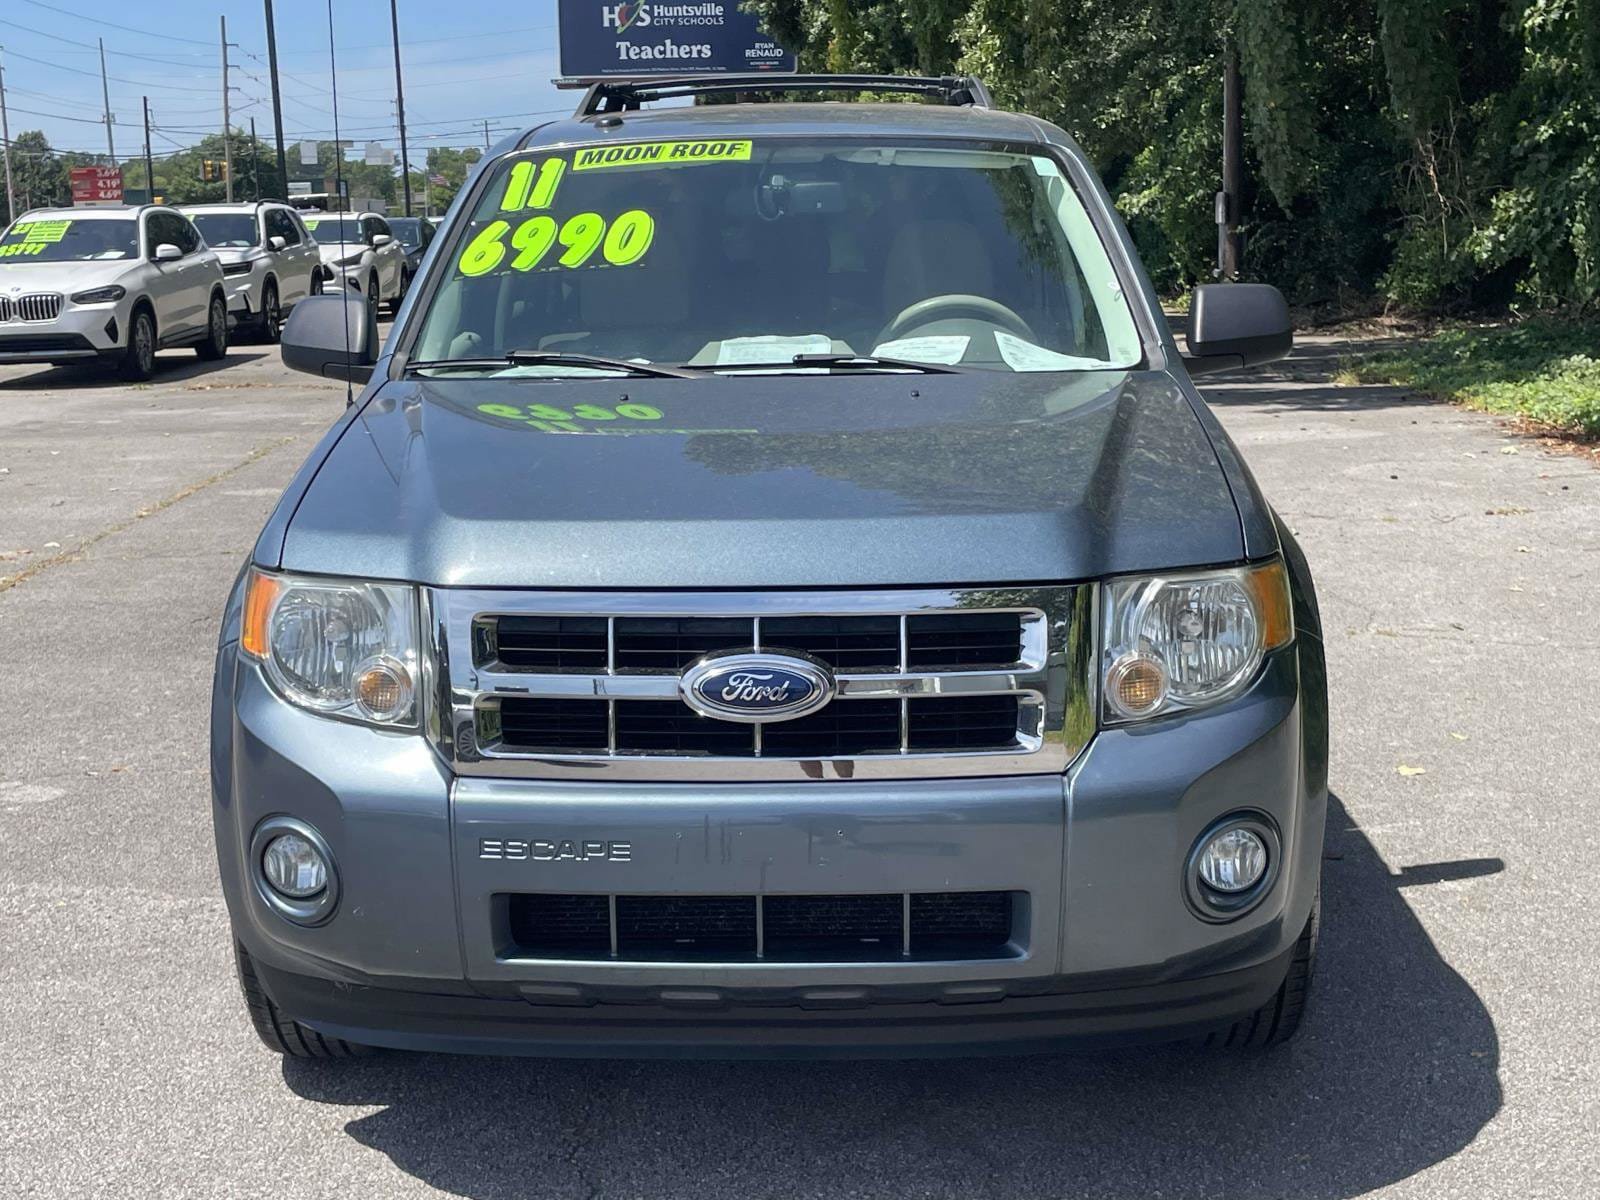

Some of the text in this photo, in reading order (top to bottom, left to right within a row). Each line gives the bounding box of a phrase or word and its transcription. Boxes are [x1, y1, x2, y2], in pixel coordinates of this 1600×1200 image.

[653, 3, 724, 16] Huntsville
[653, 17, 724, 26] CITY SCHOOLS
[616, 39, 712, 60] Teachers
[745, 48, 784, 58] RENAUD
[578, 141, 748, 166] MOON ROOF
[500, 157, 567, 212] 11
[458, 209, 655, 277] 6990
[721, 672, 790, 702] Ford
[479, 837, 632, 863] ESCAPE
